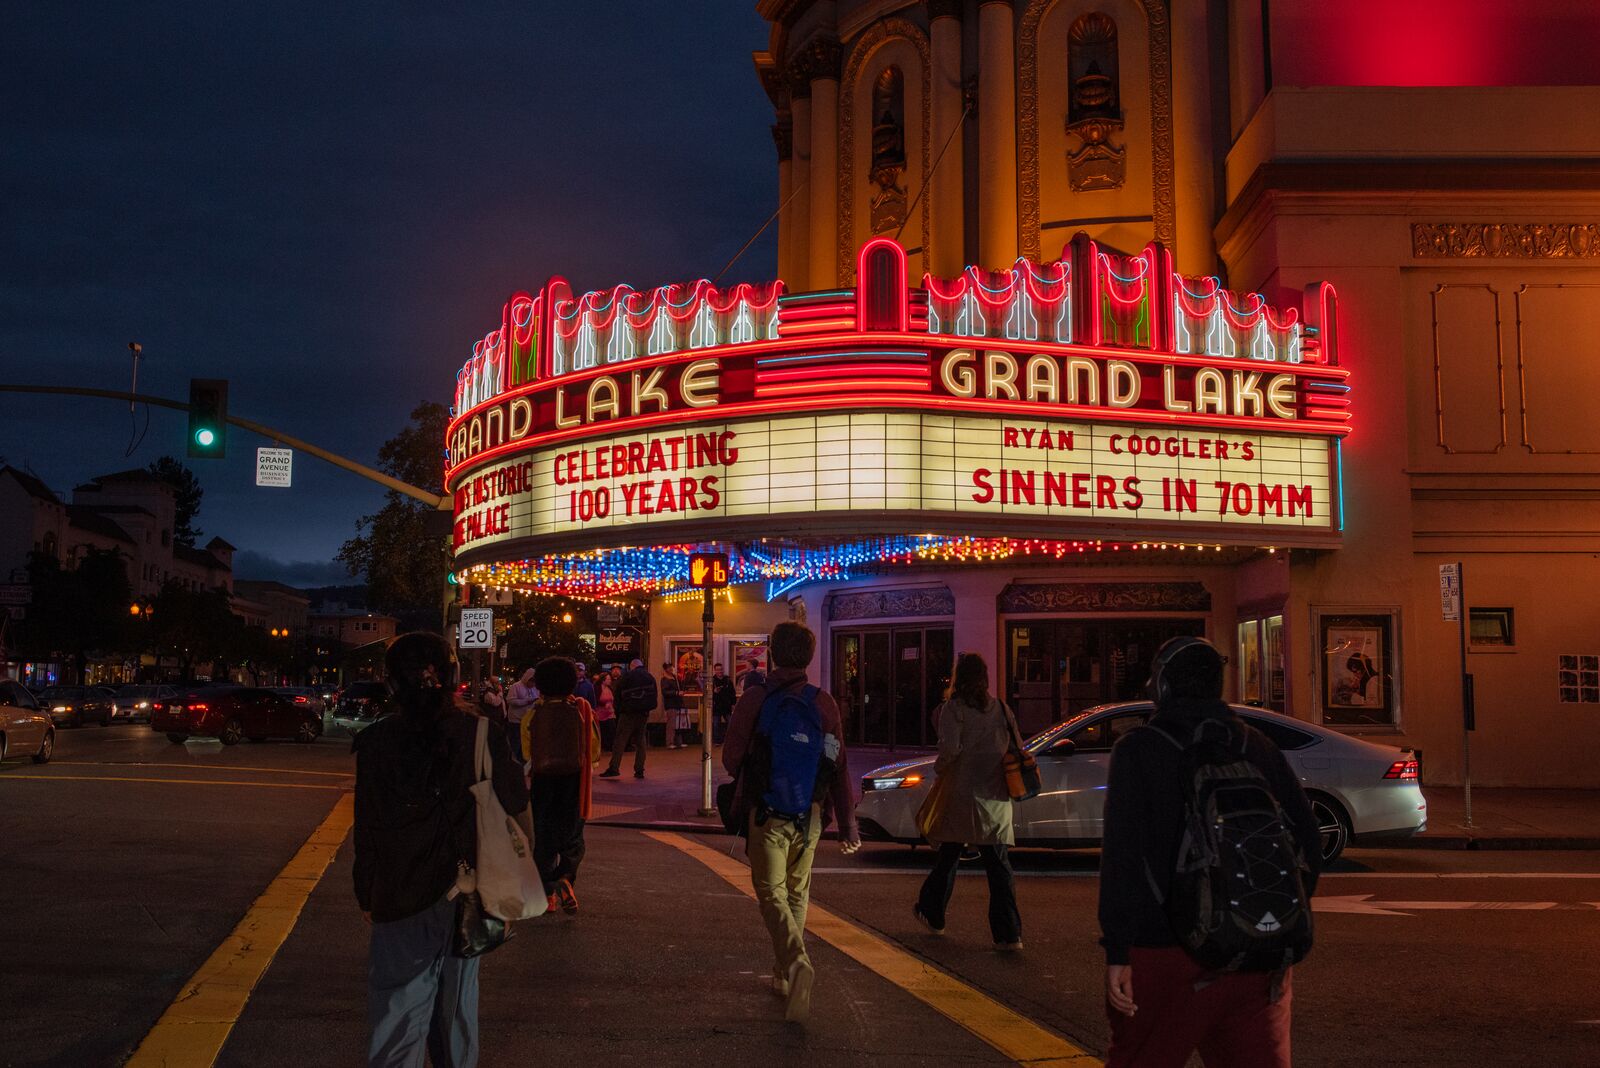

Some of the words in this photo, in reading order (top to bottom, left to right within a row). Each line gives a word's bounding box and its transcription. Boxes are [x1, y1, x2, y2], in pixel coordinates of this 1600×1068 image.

[940, 348, 1141, 408] GRAND
[1164, 364, 1297, 420] LAKE
[450, 396, 533, 468] GRAND
[555, 357, 721, 430] LAKE
[259, 456, 290, 464] GRAND
[554, 431, 738, 486] CELEBRATING
[1003, 426, 1074, 451] RYAN
[1109, 433, 1255, 461] COOGLER'S
[473, 461, 533, 507] HISTORIC
[569, 487, 610, 522] 100
[623, 475, 721, 516] YEARS
[972, 468, 1144, 511] SINNERS
[1162, 477, 1198, 513] IN
[1214, 481, 1313, 518] 70MM
[466, 502, 510, 544] PALACE
[464, 629, 488, 643] 20
